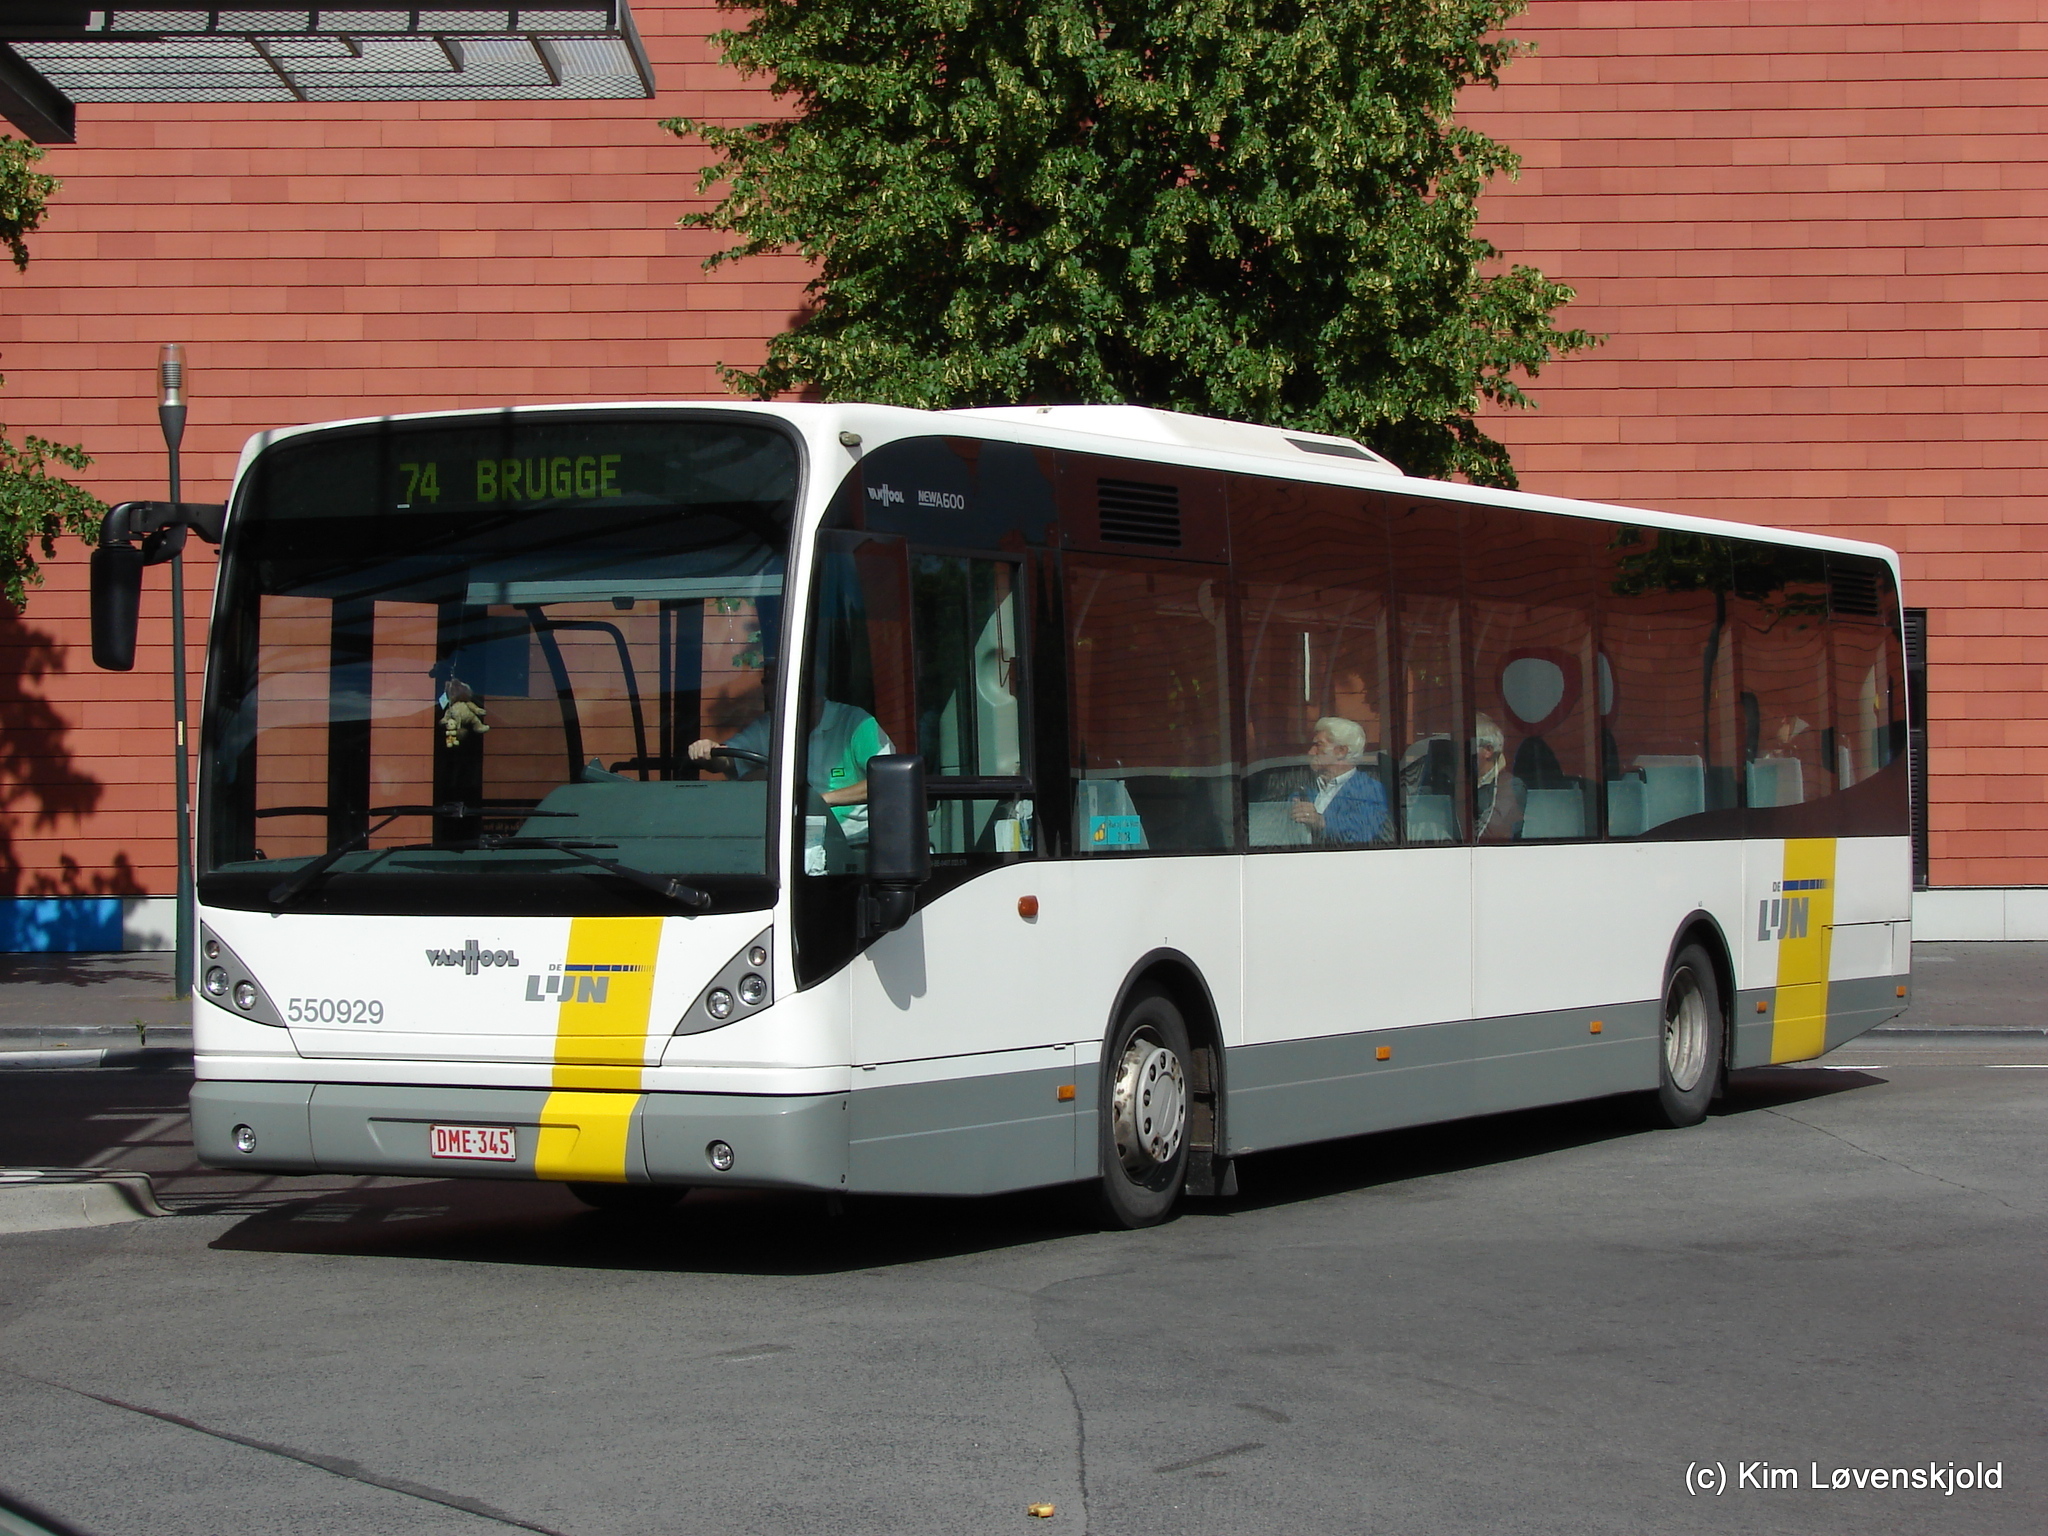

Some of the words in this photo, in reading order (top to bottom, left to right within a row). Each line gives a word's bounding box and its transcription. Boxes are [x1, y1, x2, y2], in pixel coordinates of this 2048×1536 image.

[399, 462, 440, 503] 74
[476, 454, 622, 502] BRUGGE
[1772, 881, 1781, 892] DE
[1757, 896, 1809, 942] LIJN
[548, 963, 563, 972] DE
[524, 975, 610, 1004] LIJN
[287, 997, 385, 1025] 550929
